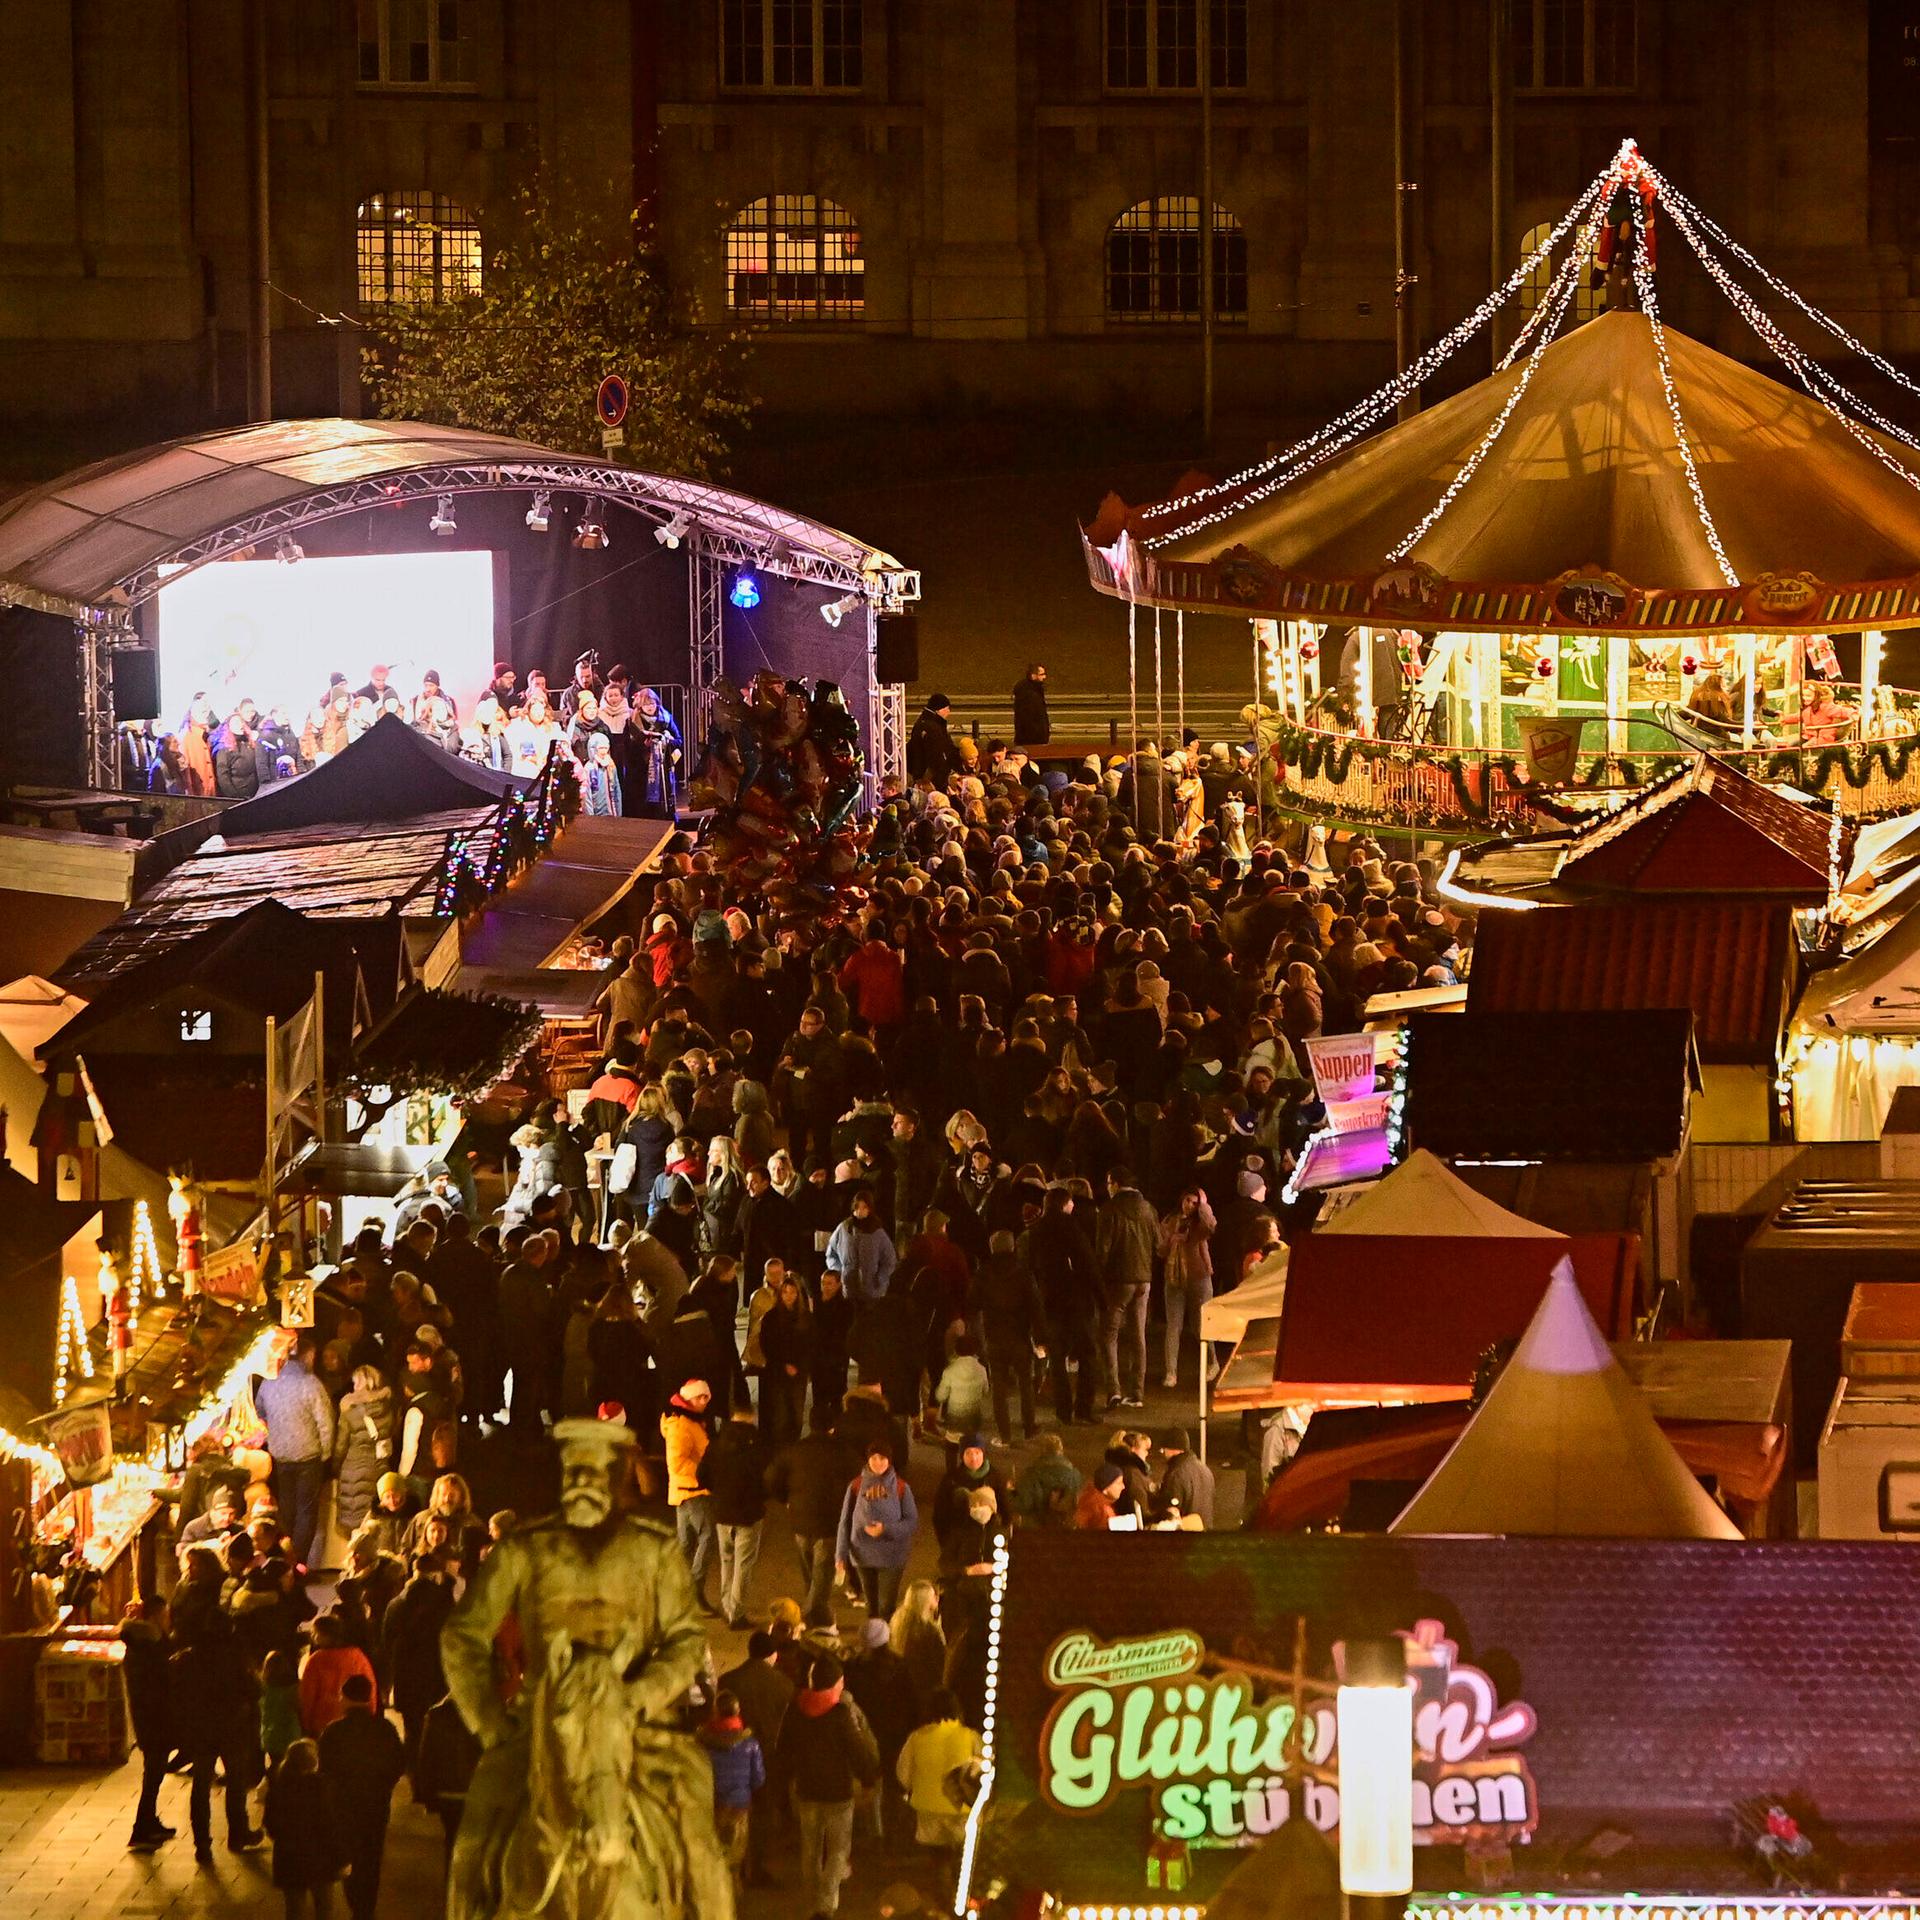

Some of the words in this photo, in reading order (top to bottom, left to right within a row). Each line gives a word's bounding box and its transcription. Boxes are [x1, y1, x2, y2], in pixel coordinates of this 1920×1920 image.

[1312, 1052, 1372, 1083] Suppen
[1050, 1676, 1525, 1808] Glühwn-
[1161, 1774, 1527, 1839] stüben
